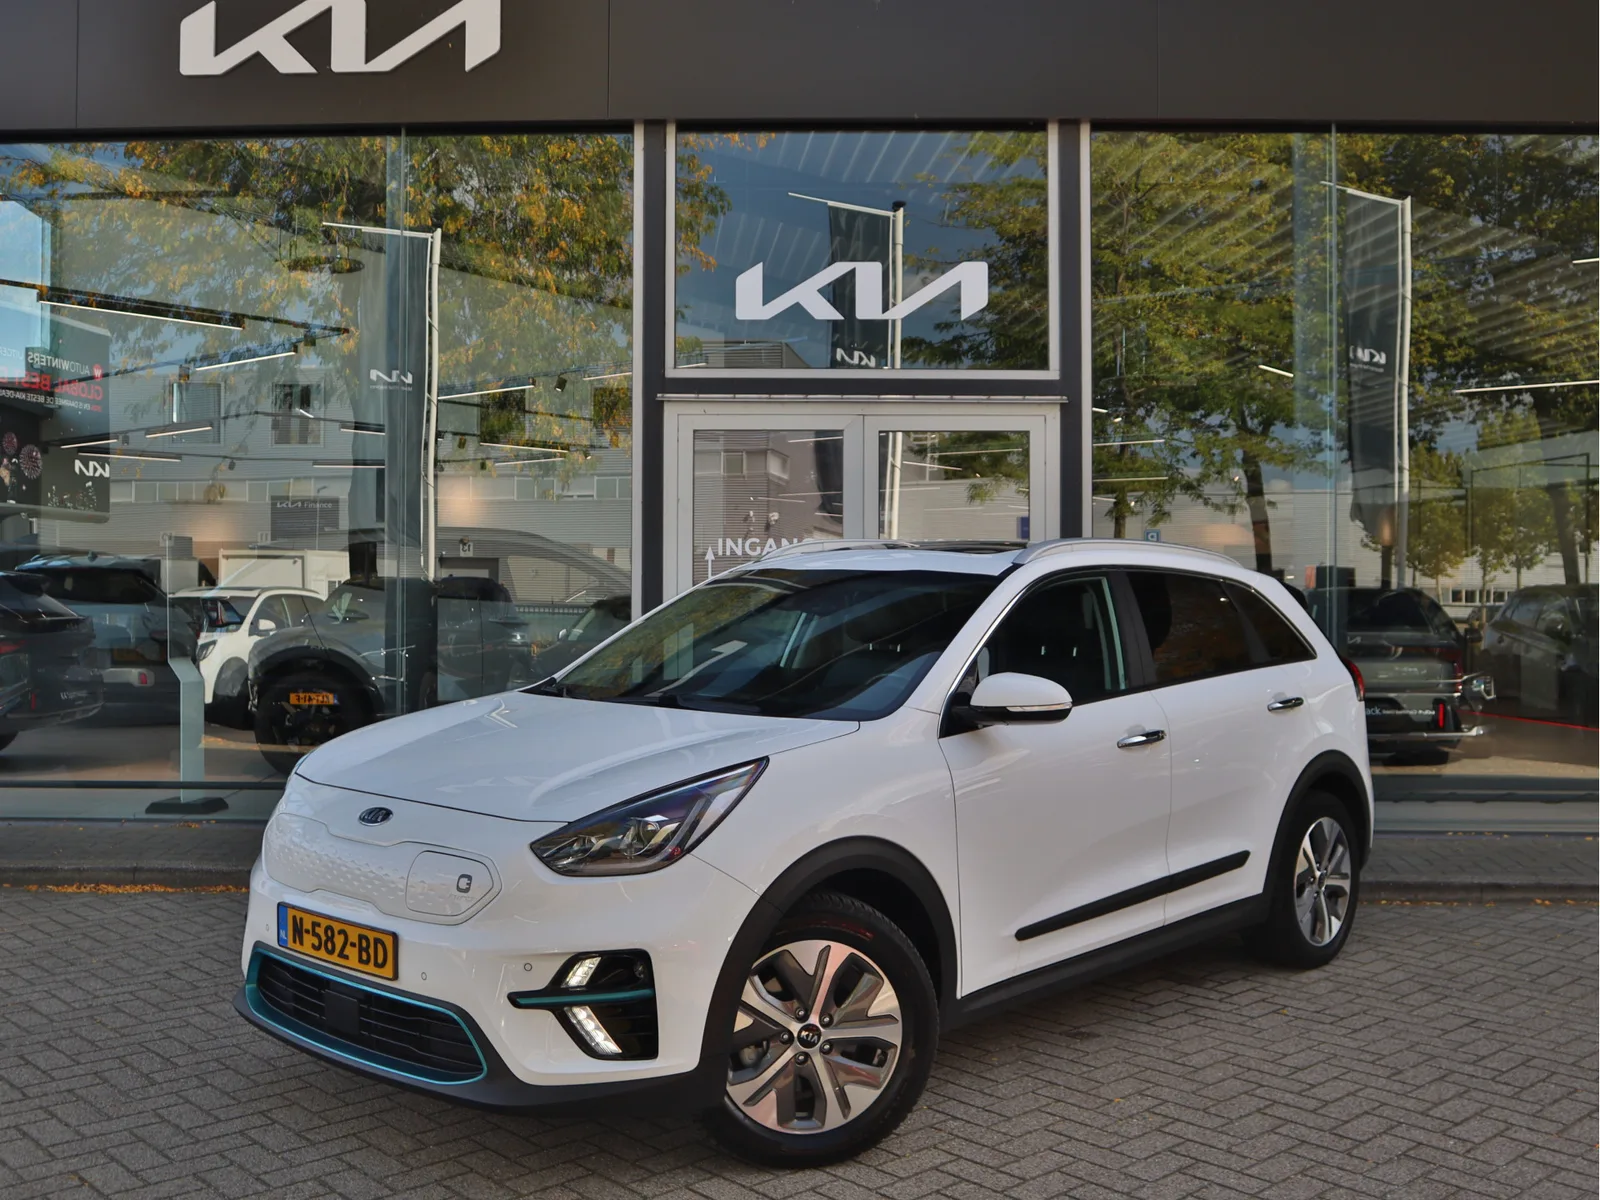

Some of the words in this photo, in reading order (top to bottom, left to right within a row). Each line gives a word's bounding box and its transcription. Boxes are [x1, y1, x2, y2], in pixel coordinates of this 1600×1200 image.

[180, 0, 500, 75] KIA
[736, 261, 989, 320] KIA
[718, 538, 815, 556] INGA
[292, 914, 388, 970] N-582-BD
[800, 1030, 818, 1044] KIA
